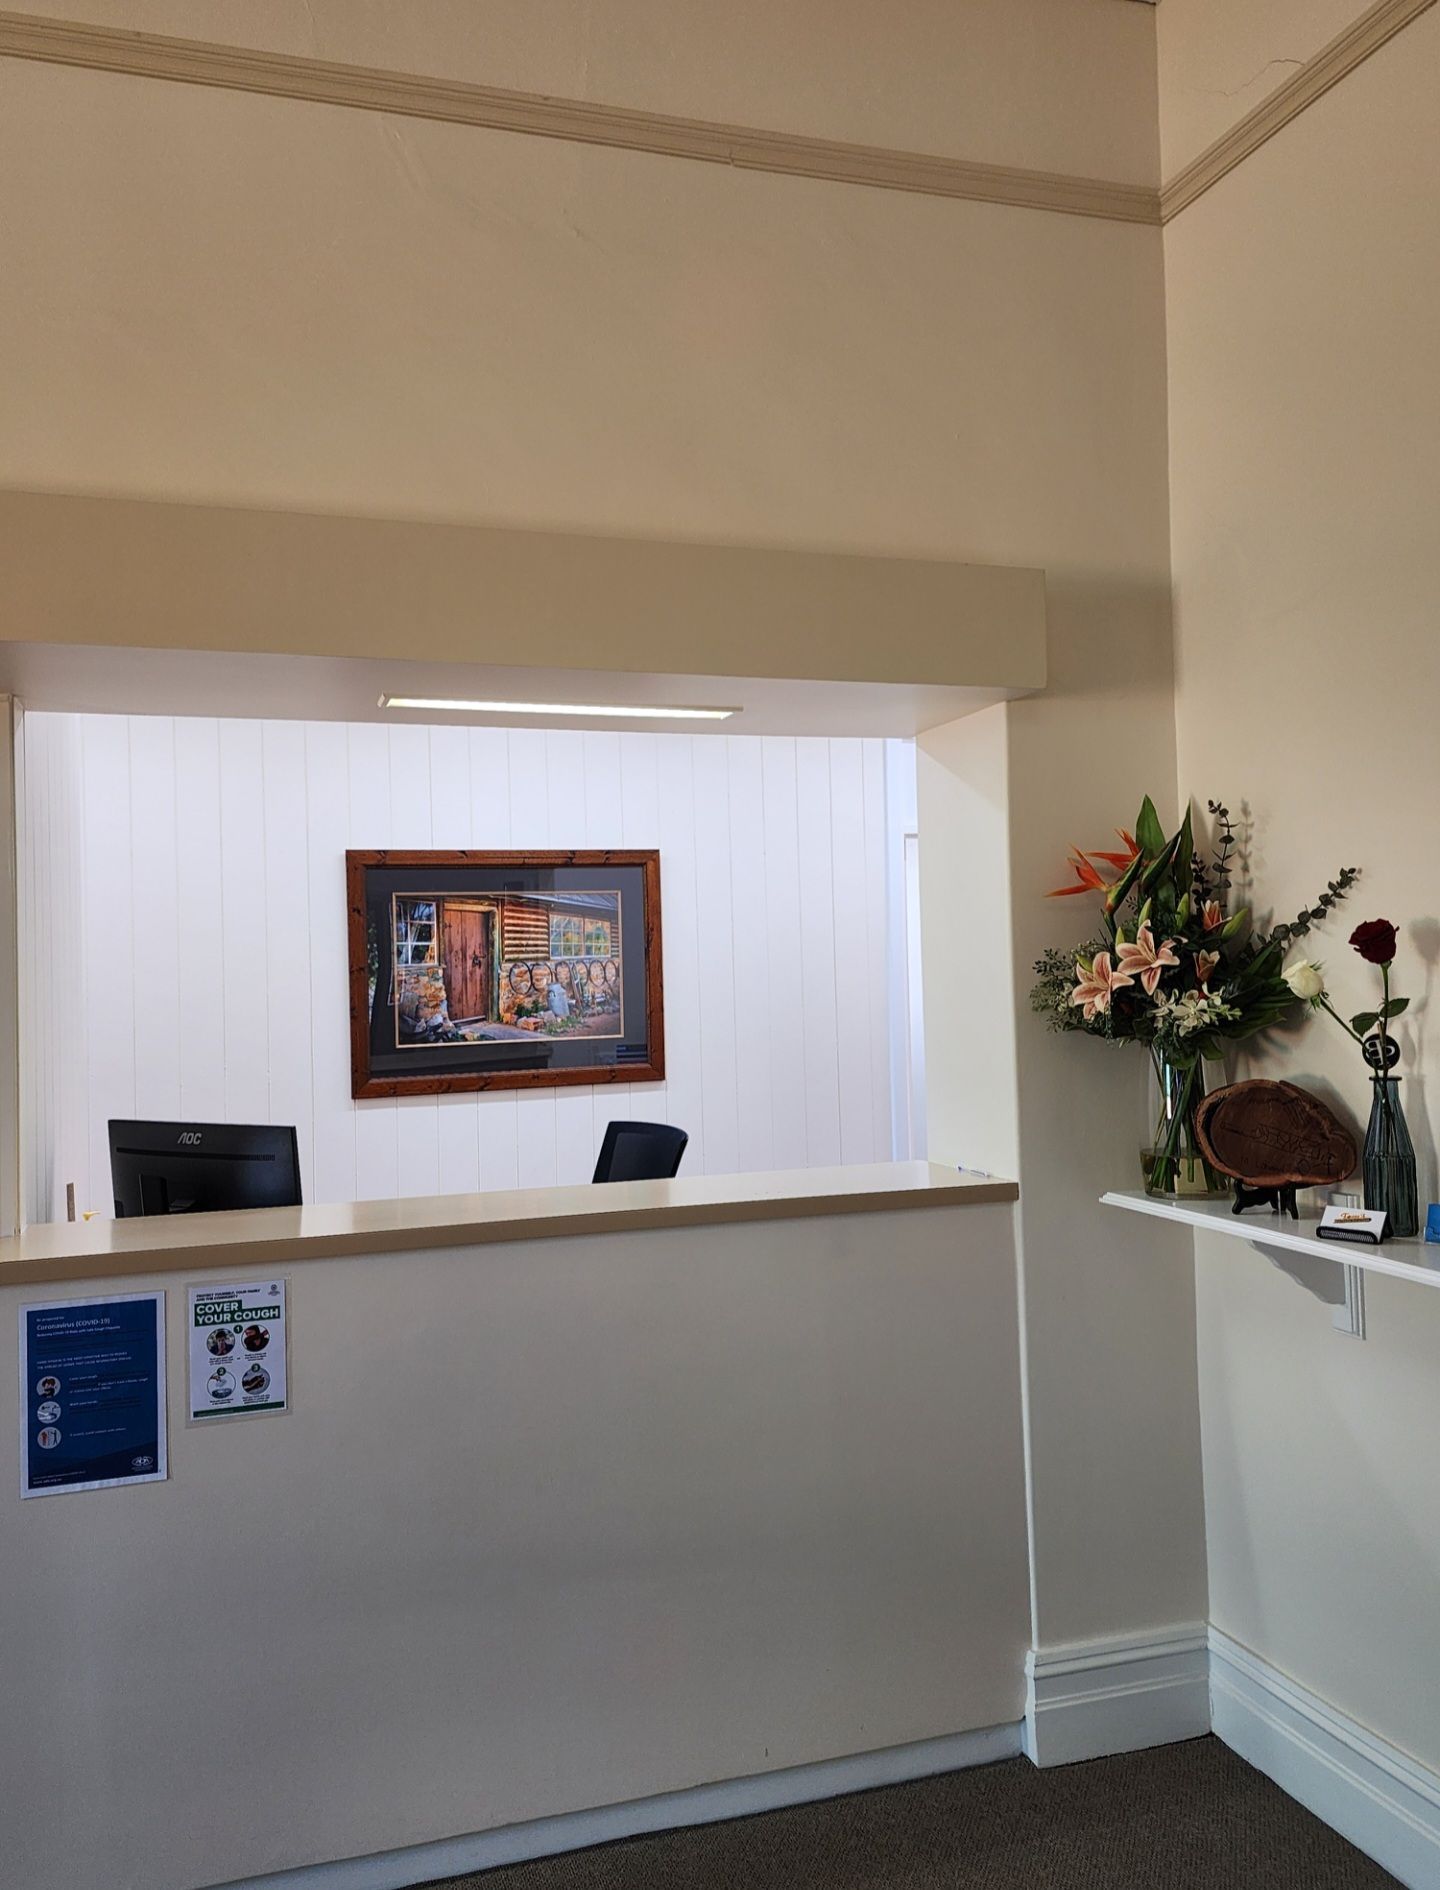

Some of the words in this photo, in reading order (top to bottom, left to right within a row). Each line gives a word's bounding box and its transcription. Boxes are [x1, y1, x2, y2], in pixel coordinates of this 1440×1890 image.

[177, 1132, 203, 1145] AOC
[196, 1303, 239, 1314] COVER
[196, 1313, 231, 1325] YOUR
[234, 1308, 279, 1321] COUGH
[36, 1322, 75, 1331] Coronavirus
[75, 1318, 110, 1328] (COVID-19)
